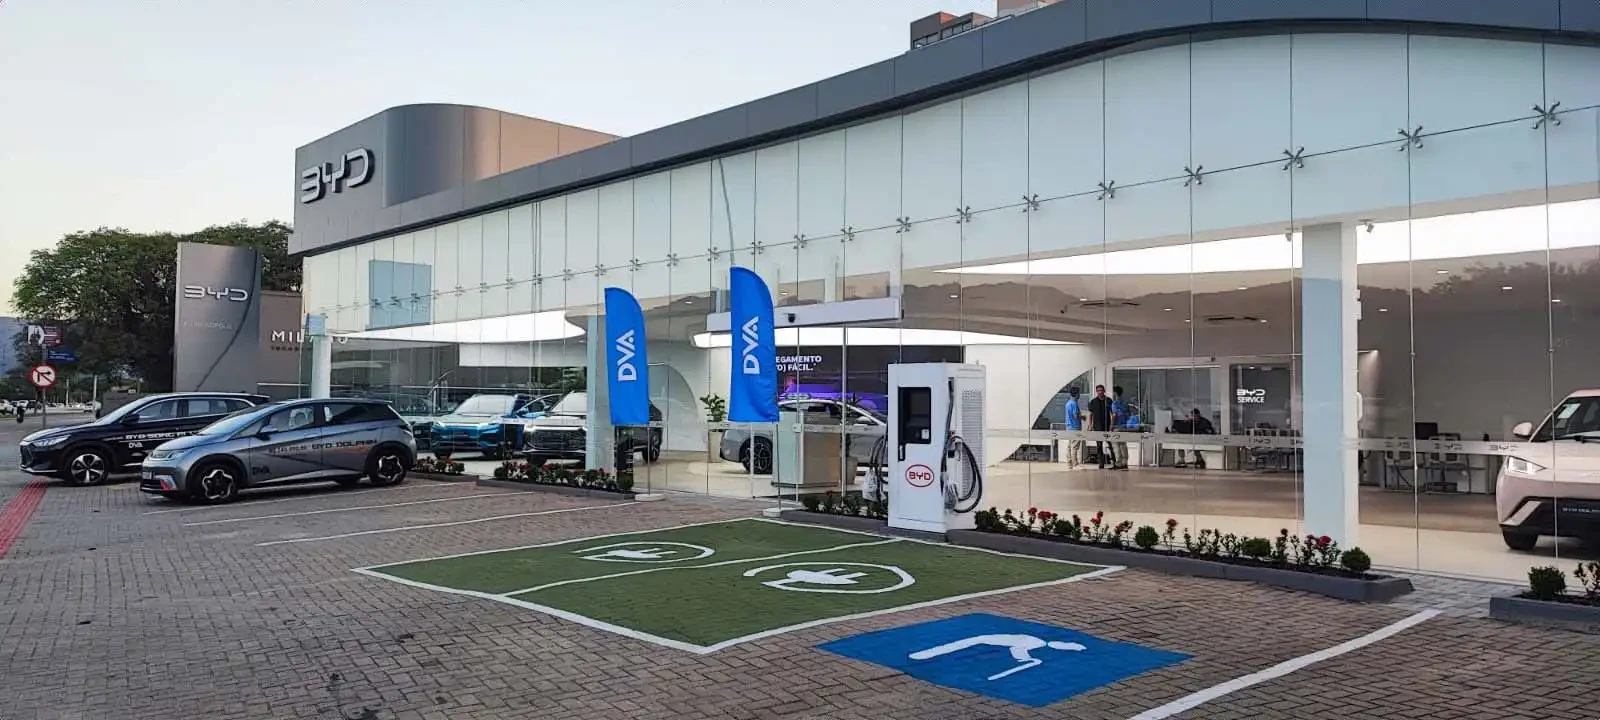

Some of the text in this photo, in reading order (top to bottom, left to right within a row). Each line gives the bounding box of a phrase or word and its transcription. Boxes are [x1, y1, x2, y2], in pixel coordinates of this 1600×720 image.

[300, 147, 374, 203] BYD
[184, 285, 249, 301] BYD
[616, 329, 637, 381] DVA
[742, 316, 760, 375] DVA
[776, 355, 822, 363] EGAMENTO
[908, 471, 931, 481] BYD
